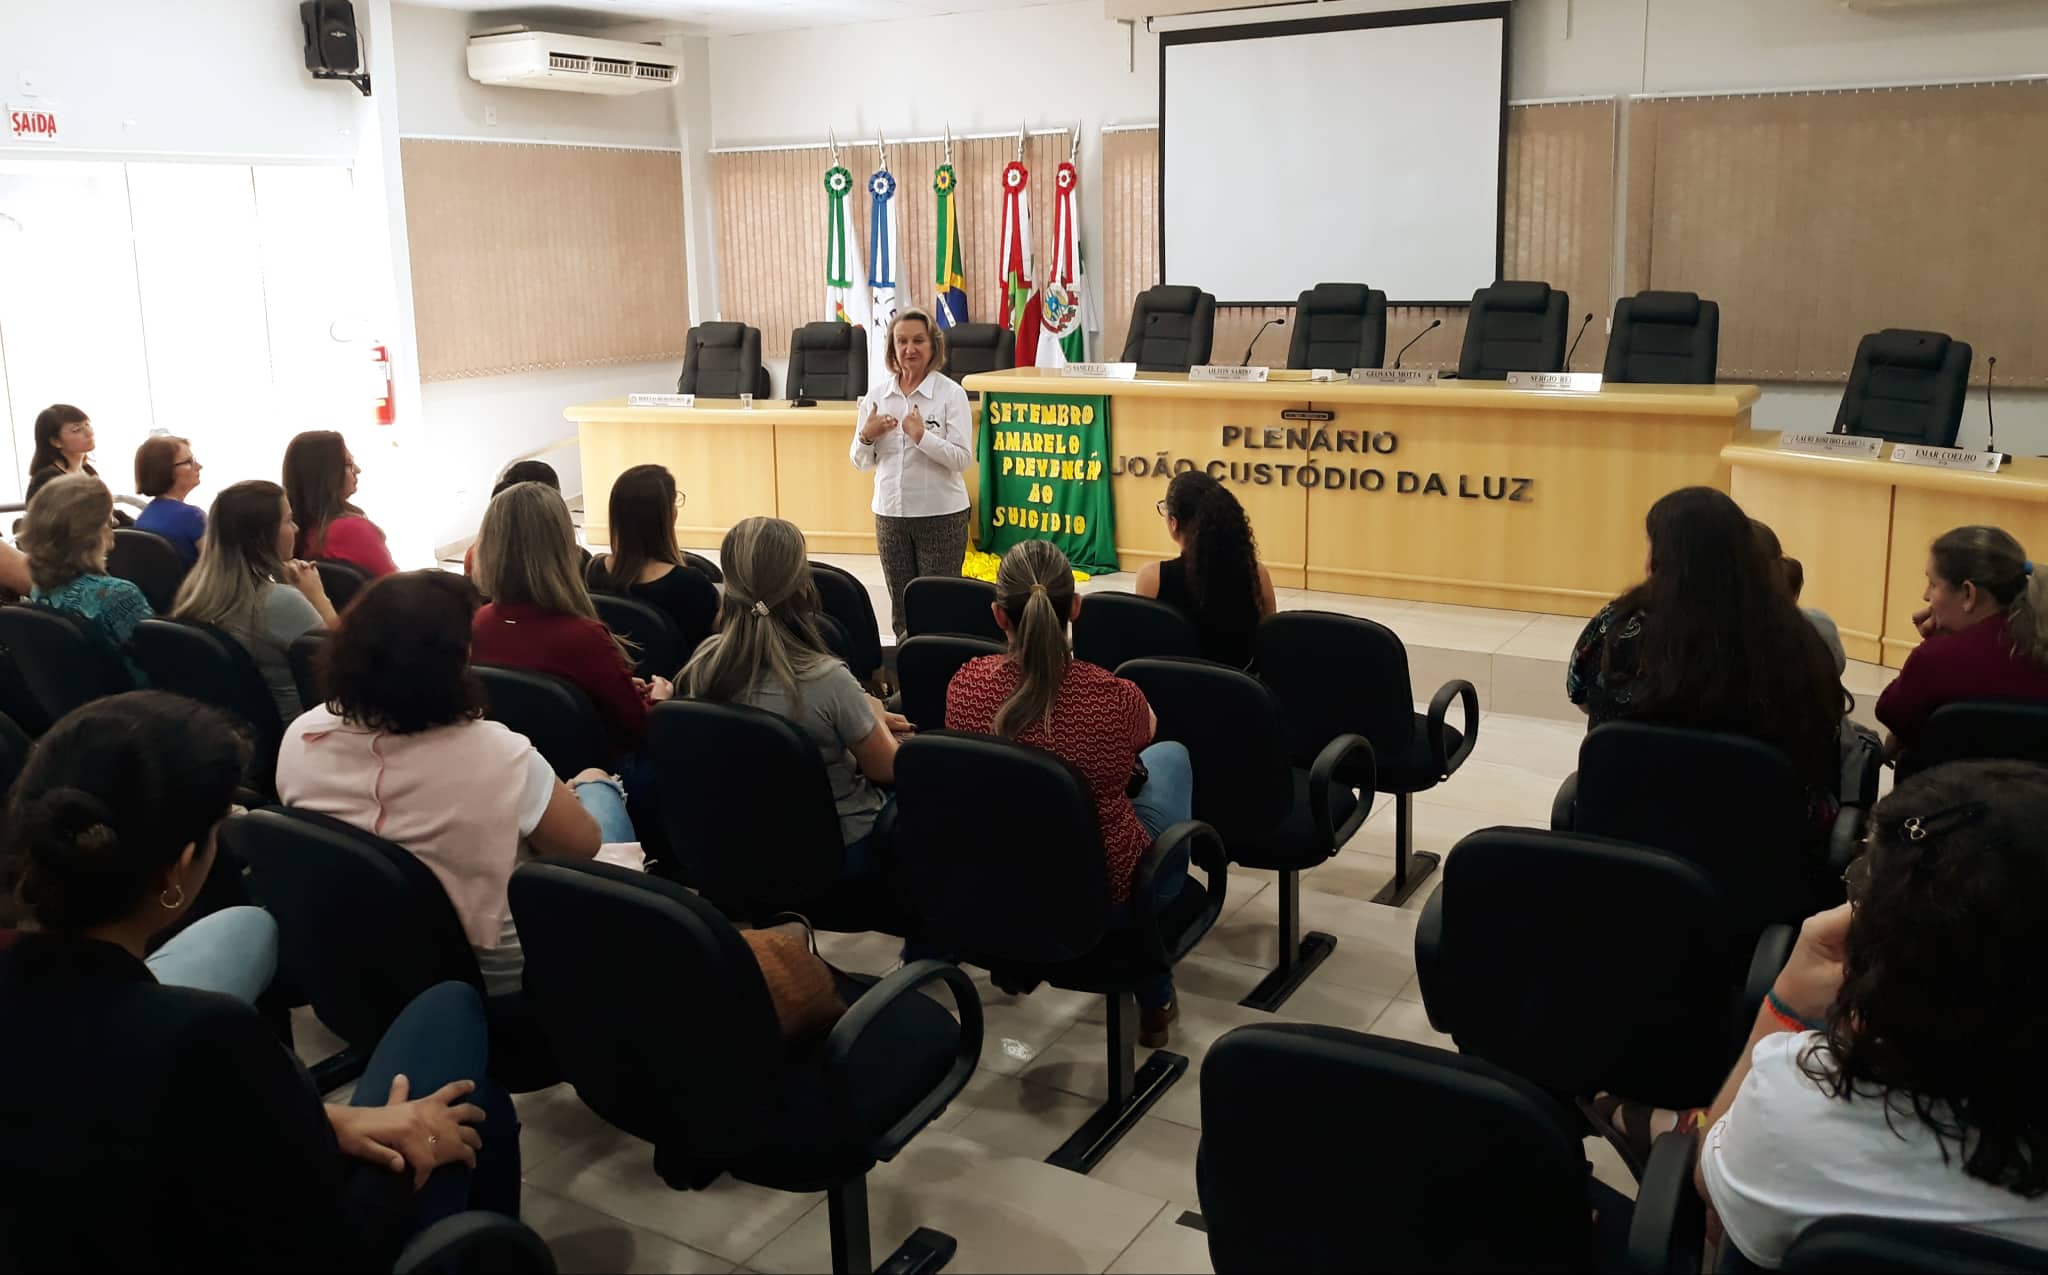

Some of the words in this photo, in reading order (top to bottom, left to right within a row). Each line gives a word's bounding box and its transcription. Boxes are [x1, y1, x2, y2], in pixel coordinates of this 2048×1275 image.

[989, 401, 1094, 426] SETEMBRO
[993, 431, 1080, 454] AMARELO
[1222, 424, 1398, 454] PLENÁRIO
[1028, 482, 1053, 504] AO
[1206, 459, 1384, 492] CUSTÓDIO
[1397, 471, 1447, 496] DA
[1459, 475, 1534, 502] LUZ
